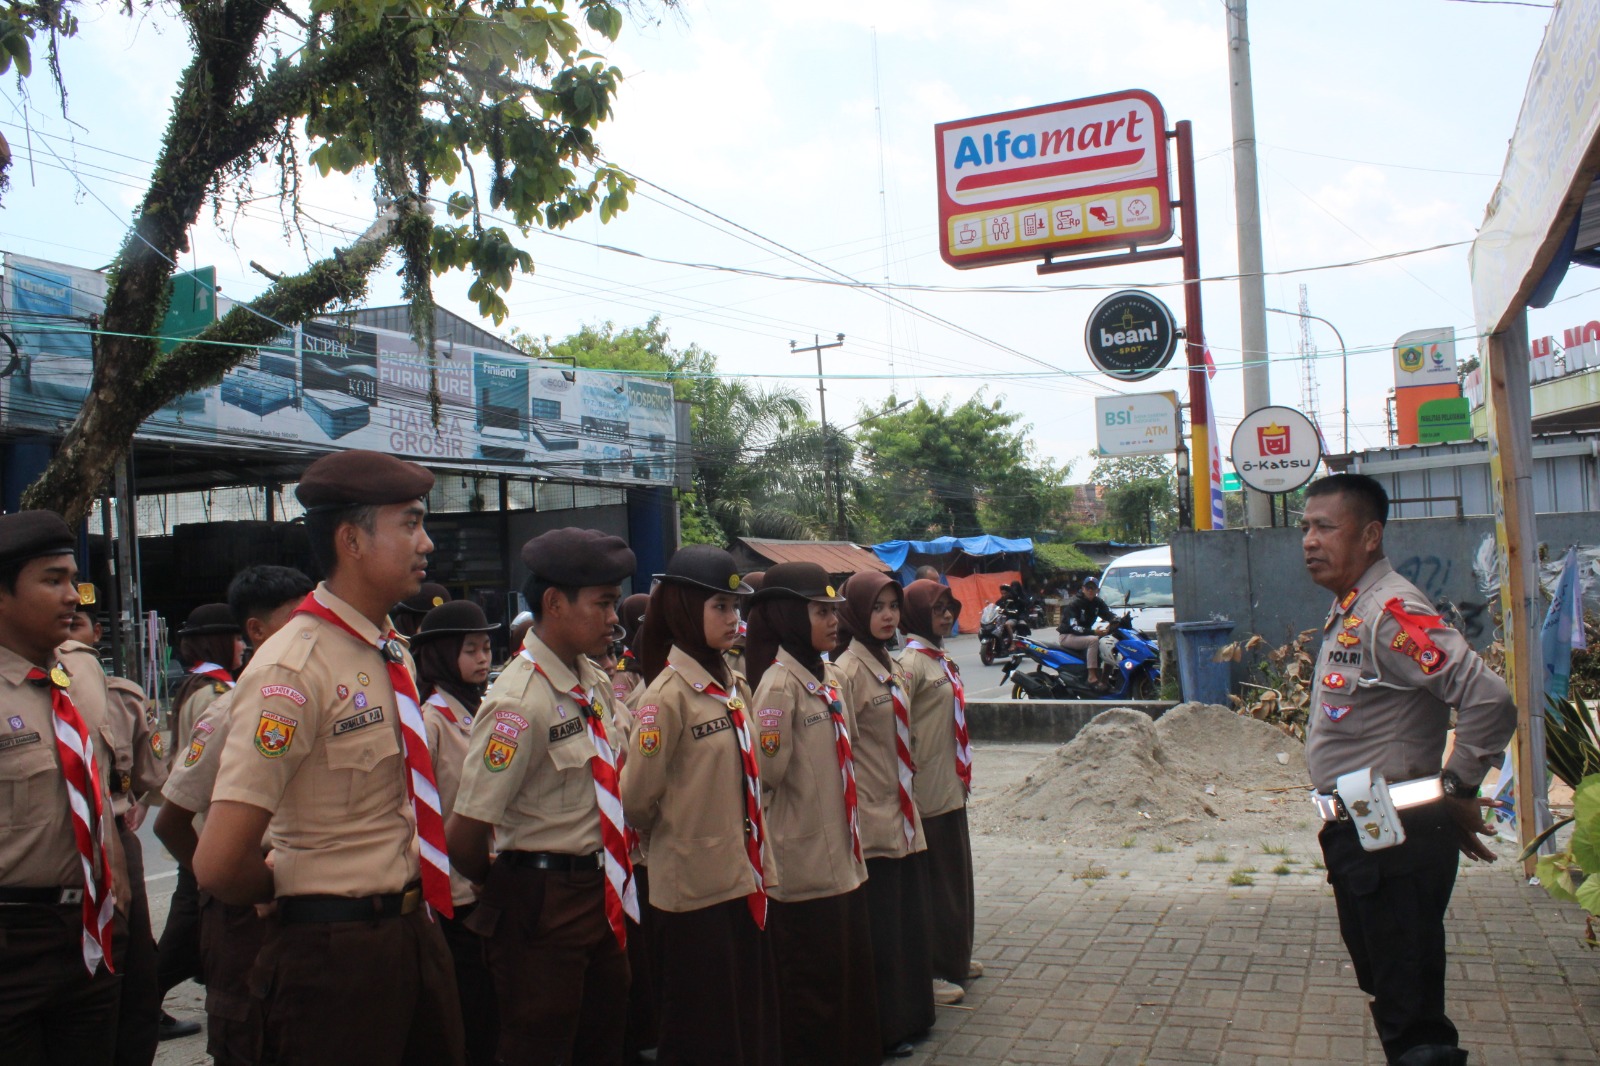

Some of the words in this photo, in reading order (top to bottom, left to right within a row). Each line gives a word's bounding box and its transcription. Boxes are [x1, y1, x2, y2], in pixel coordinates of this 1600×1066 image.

[954, 110, 1144, 170] Alfamart
[1069, 217, 1081, 227] Rp
[1100, 321, 1158, 348] bean!
[305, 336, 349, 360] SUPER
[1119, 345, 1142, 355] SPOT
[380, 349, 430, 371] BERKA
[438, 360, 469, 377] JAYA
[379, 367, 470, 397] FURNIURE
[1105, 408, 1132, 427] BSI
[1145, 425, 1168, 437] ATM
[389, 431, 464, 458] GROSIR
[1328, 650, 1361, 665] POLRI
[263, 712, 279, 721] JAWA
[497, 712, 527, 729] BOGOR
[551, 720, 582, 739] BADRU
[696, 718, 728, 735] ZAZA
